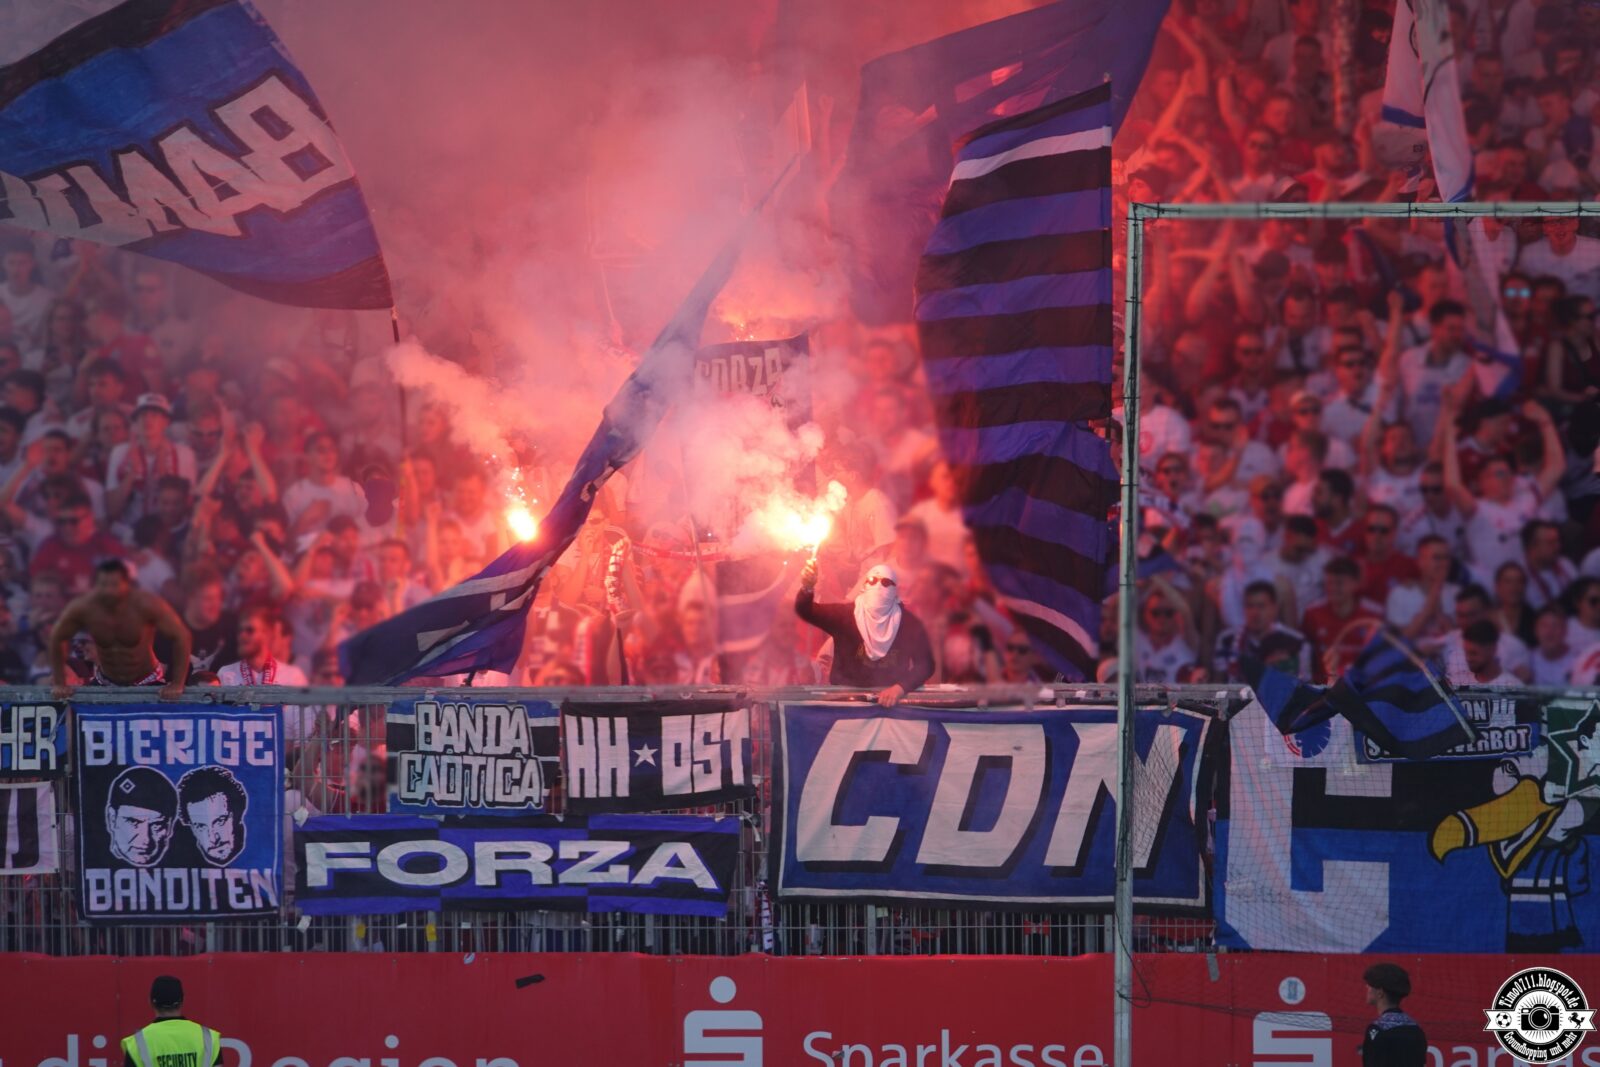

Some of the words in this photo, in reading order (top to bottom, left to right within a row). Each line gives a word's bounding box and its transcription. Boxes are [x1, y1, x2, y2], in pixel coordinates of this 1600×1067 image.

[81, 718, 274, 767] BIERIGE
[416, 702, 532, 755] BANDA
[565, 713, 630, 799] HH
[661, 707, 750, 797] OST
[401, 753, 544, 808] CAOTICA
[796, 717, 1188, 869] CDN
[85, 867, 279, 912] BANDITEN
[305, 839, 719, 890] FORZA
